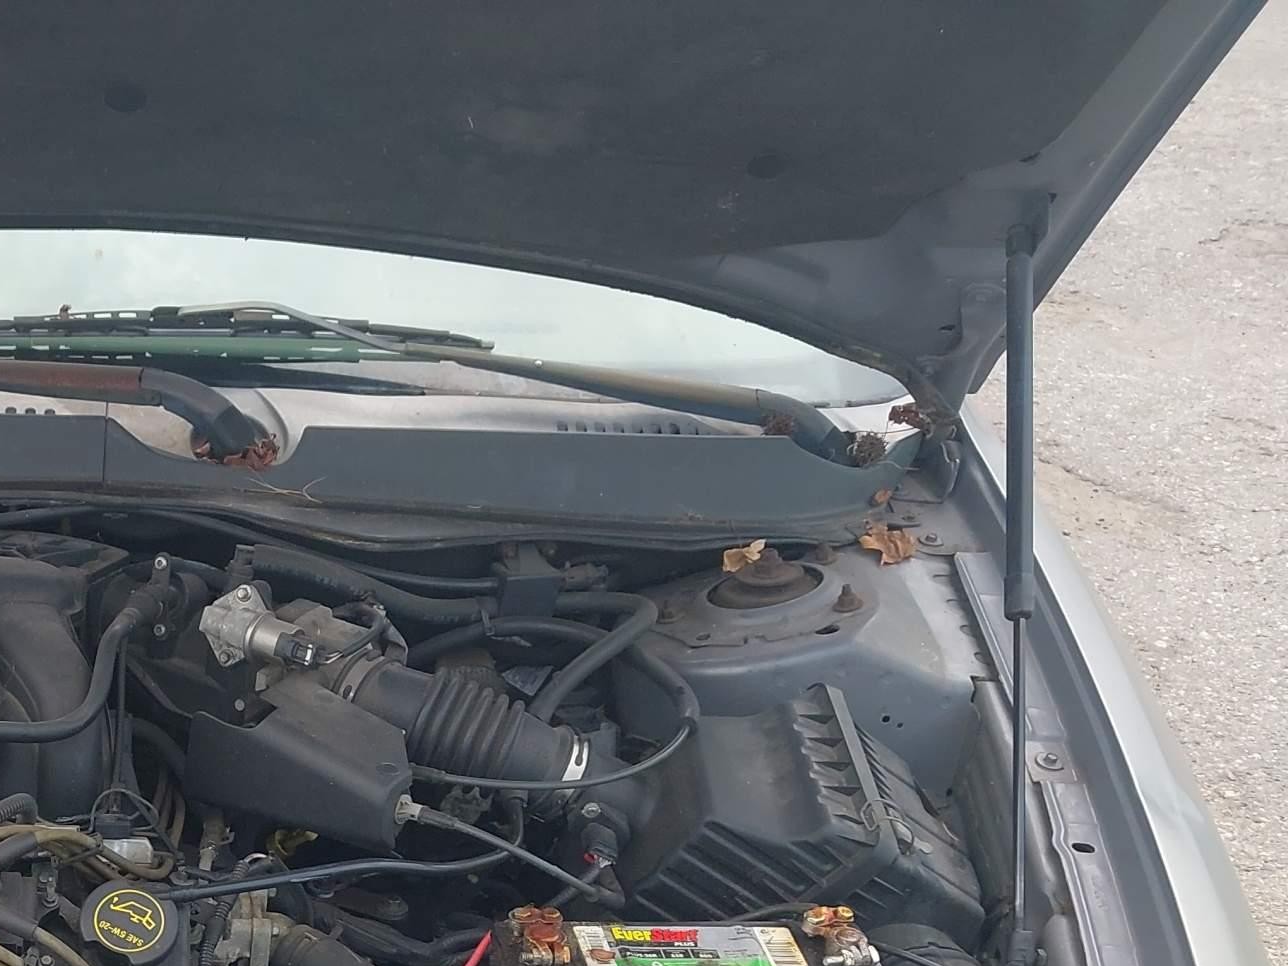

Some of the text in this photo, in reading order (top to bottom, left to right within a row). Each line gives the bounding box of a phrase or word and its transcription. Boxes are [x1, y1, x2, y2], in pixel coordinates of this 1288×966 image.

[99, 921, 144, 947] SAE 5W-20
[611, 926, 698, 942] EverStart
